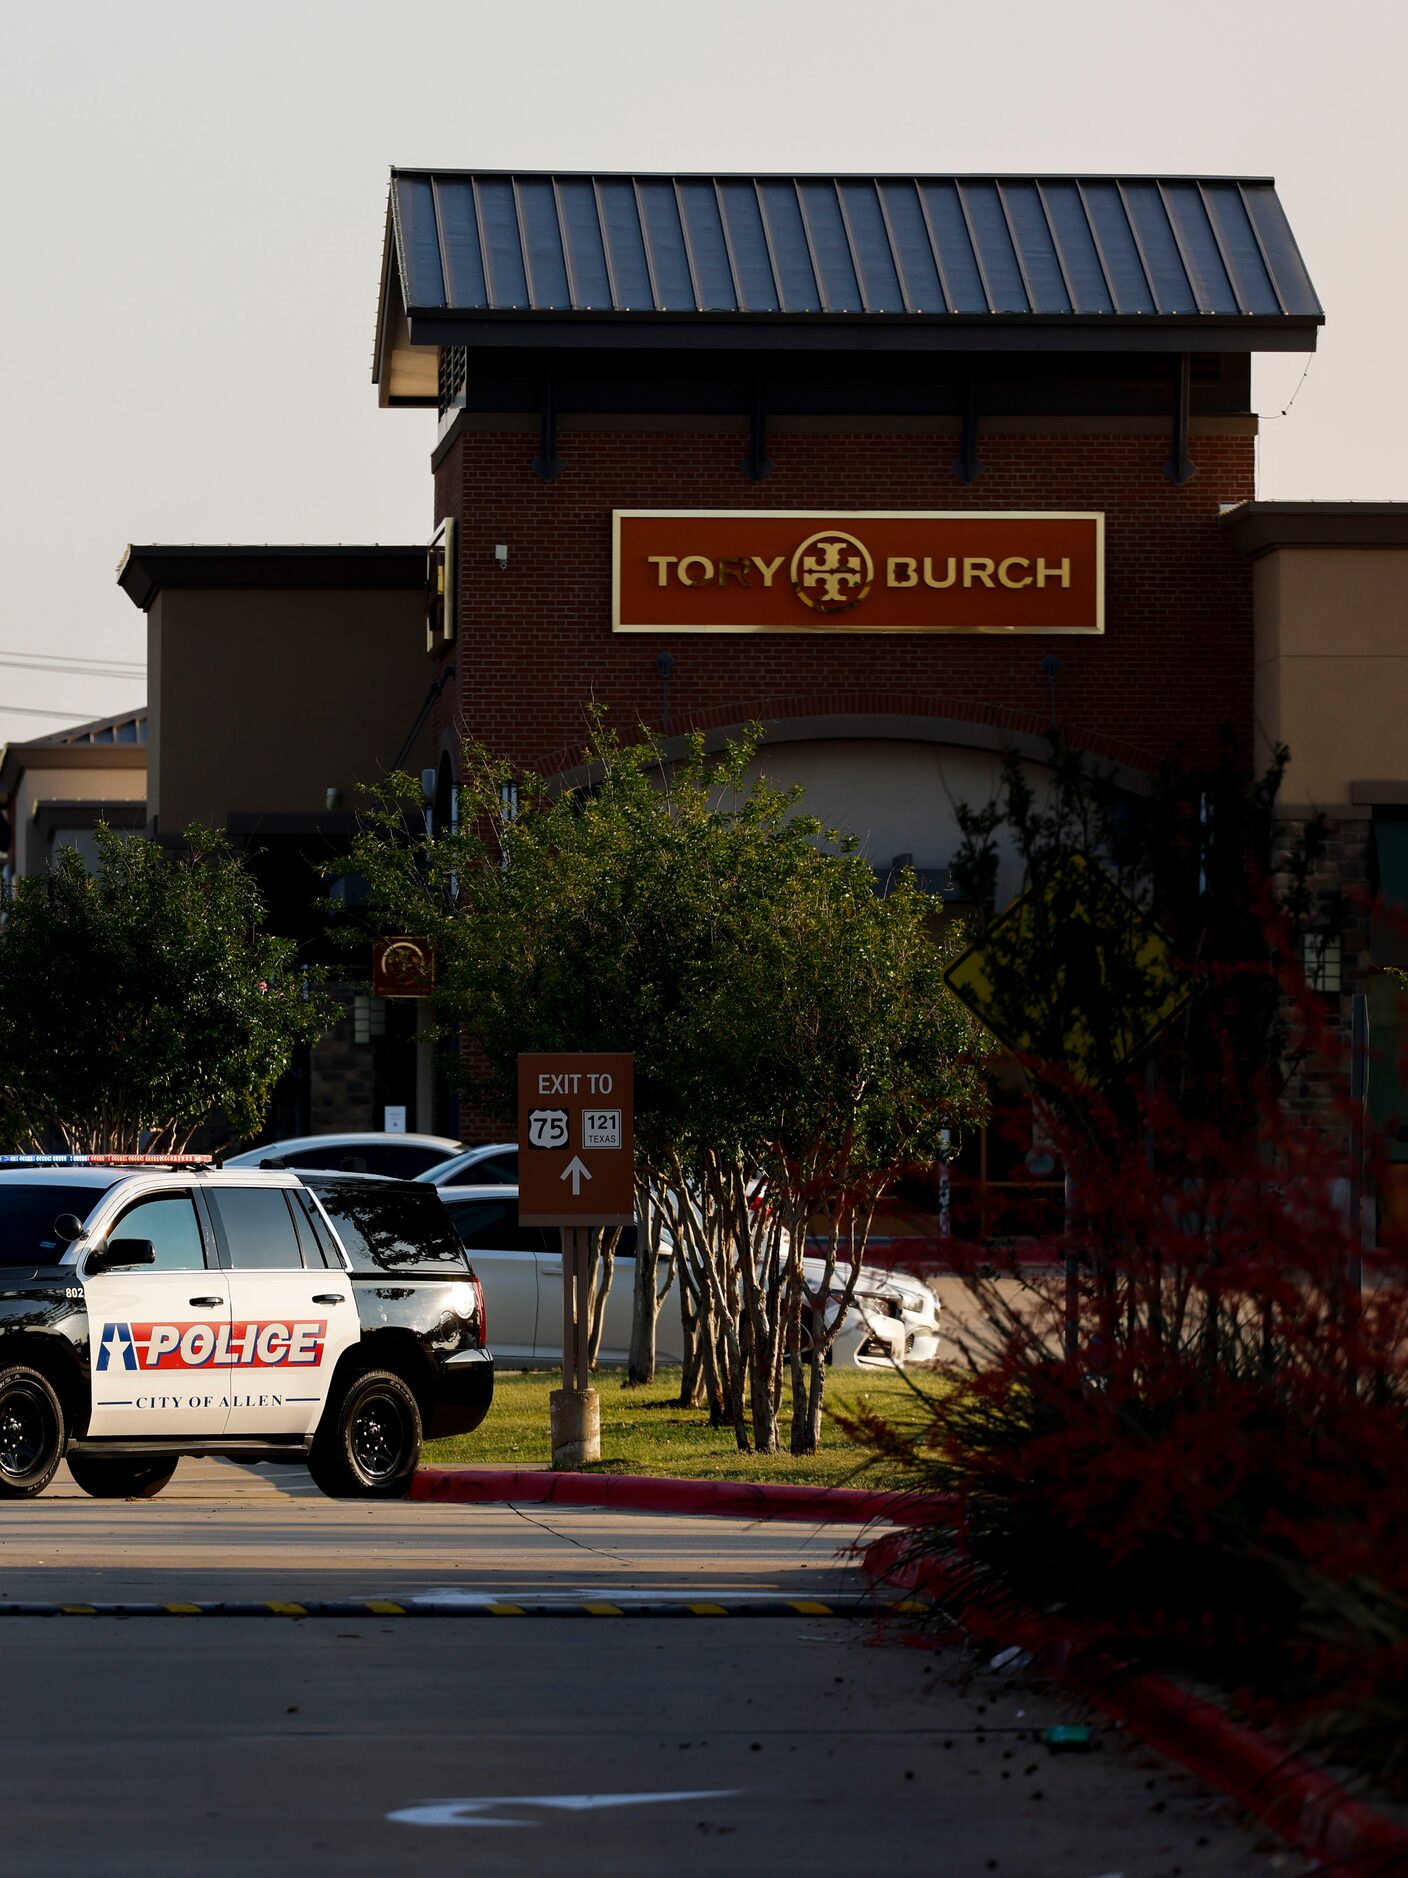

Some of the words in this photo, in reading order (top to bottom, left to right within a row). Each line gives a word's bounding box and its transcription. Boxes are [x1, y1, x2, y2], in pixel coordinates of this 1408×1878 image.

[647, 555, 786, 588] TORY
[886, 556, 1071, 589] BURCH
[538, 1073, 582, 1095] EXIT
[587, 1073, 613, 1095] TO
[533, 1118, 564, 1140] 75
[587, 1115, 616, 1130] 121
[588, 1134, 616, 1144] TEXAS
[65, 1287, 85, 1298] 802
[145, 1322, 322, 1367] POLICE
[136, 1396, 183, 1409] CITY
[188, 1396, 213, 1409] OF
[219, 1395, 283, 1408] ALLEN
